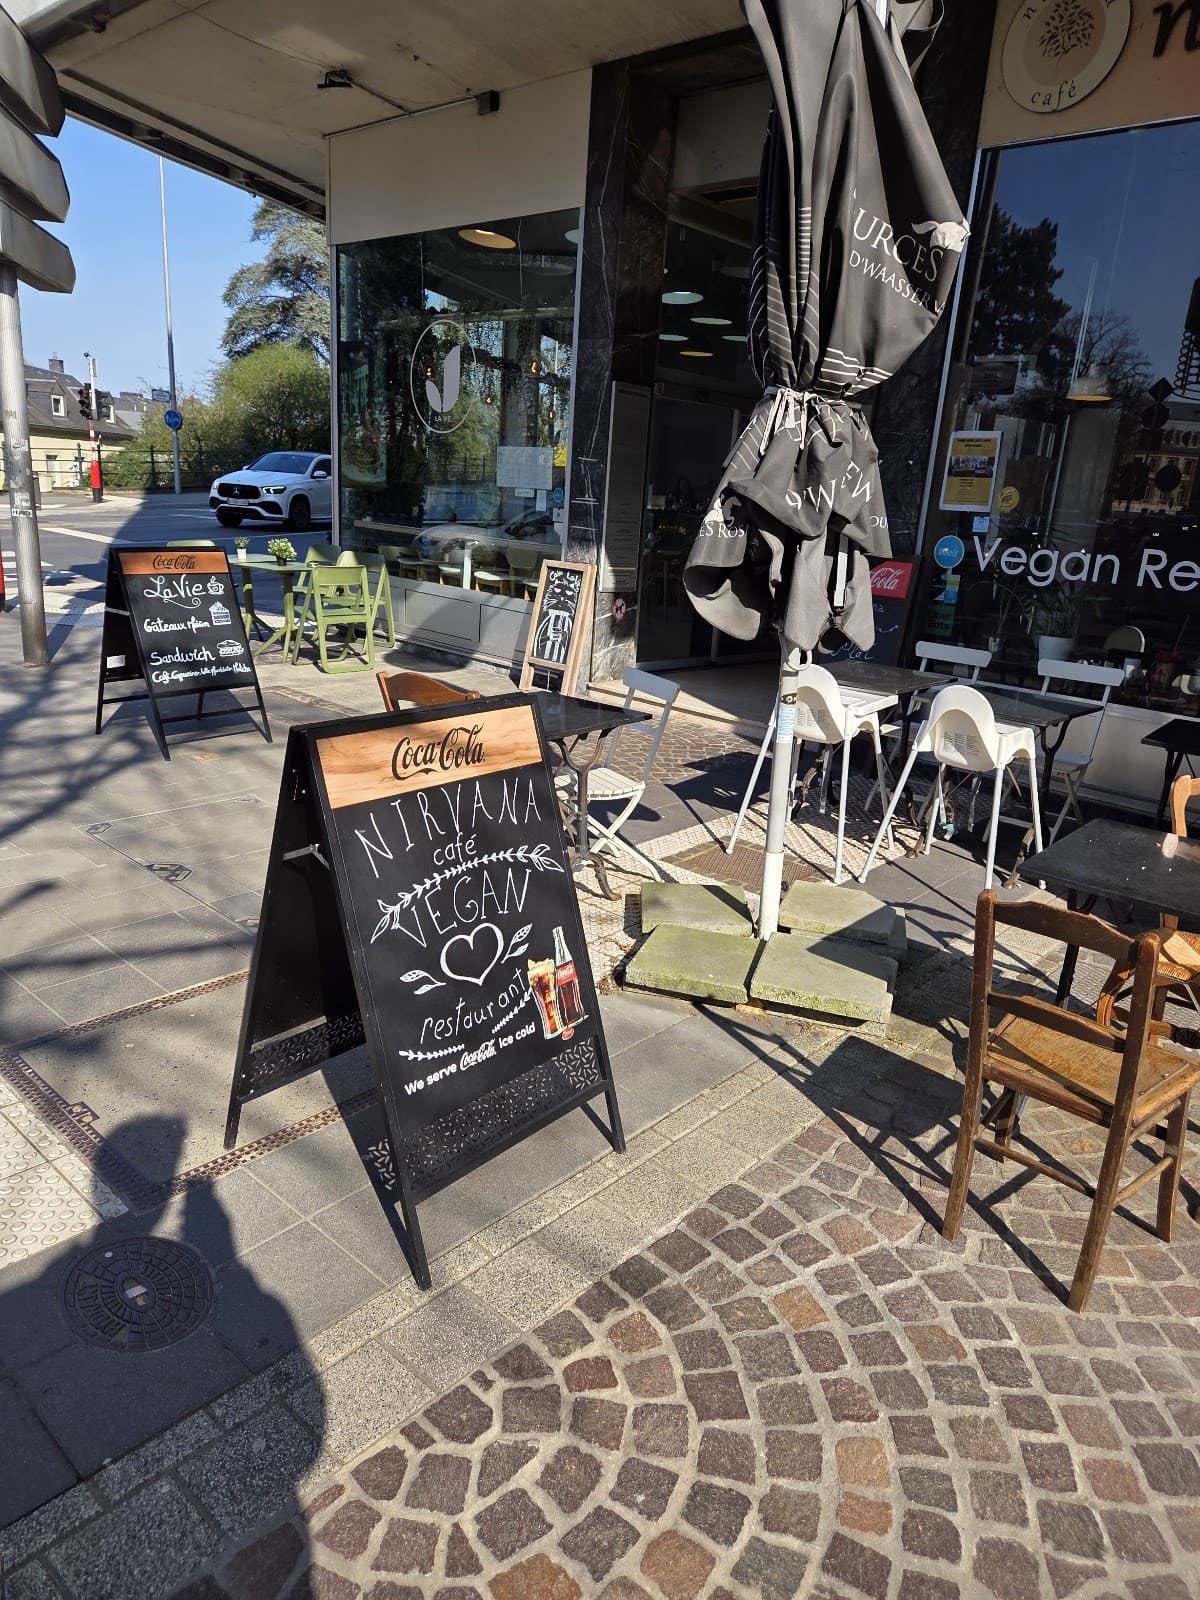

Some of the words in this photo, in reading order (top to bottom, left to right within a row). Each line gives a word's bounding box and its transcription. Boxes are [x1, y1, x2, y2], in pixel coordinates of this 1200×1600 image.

[1031, 80, 1077, 111] café
[853, 207, 944, 282] URCES
[717, 522, 748, 538] ROS
[869, 515, 888, 529] OU
[152, 554, 197, 570] Coca-Cola
[973, 536, 1121, 587] Vegan
[1136, 548, 1200, 592] Re
[143, 617, 186, 633] Gâteaux
[150, 646, 216, 666] Sandwich
[391, 724, 486, 781] Coca-Cola
[354, 777, 544, 879] NIRVANA
[433, 831, 477, 866] café
[395, 867, 532, 948] VEGAN
[420, 968, 527, 1045] restaurant
[404, 1080, 425, 1096] We
[426, 1063, 457, 1086] serve
[459, 1037, 497, 1071] Coca-Cola
[515, 1021, 536, 1041] cold
